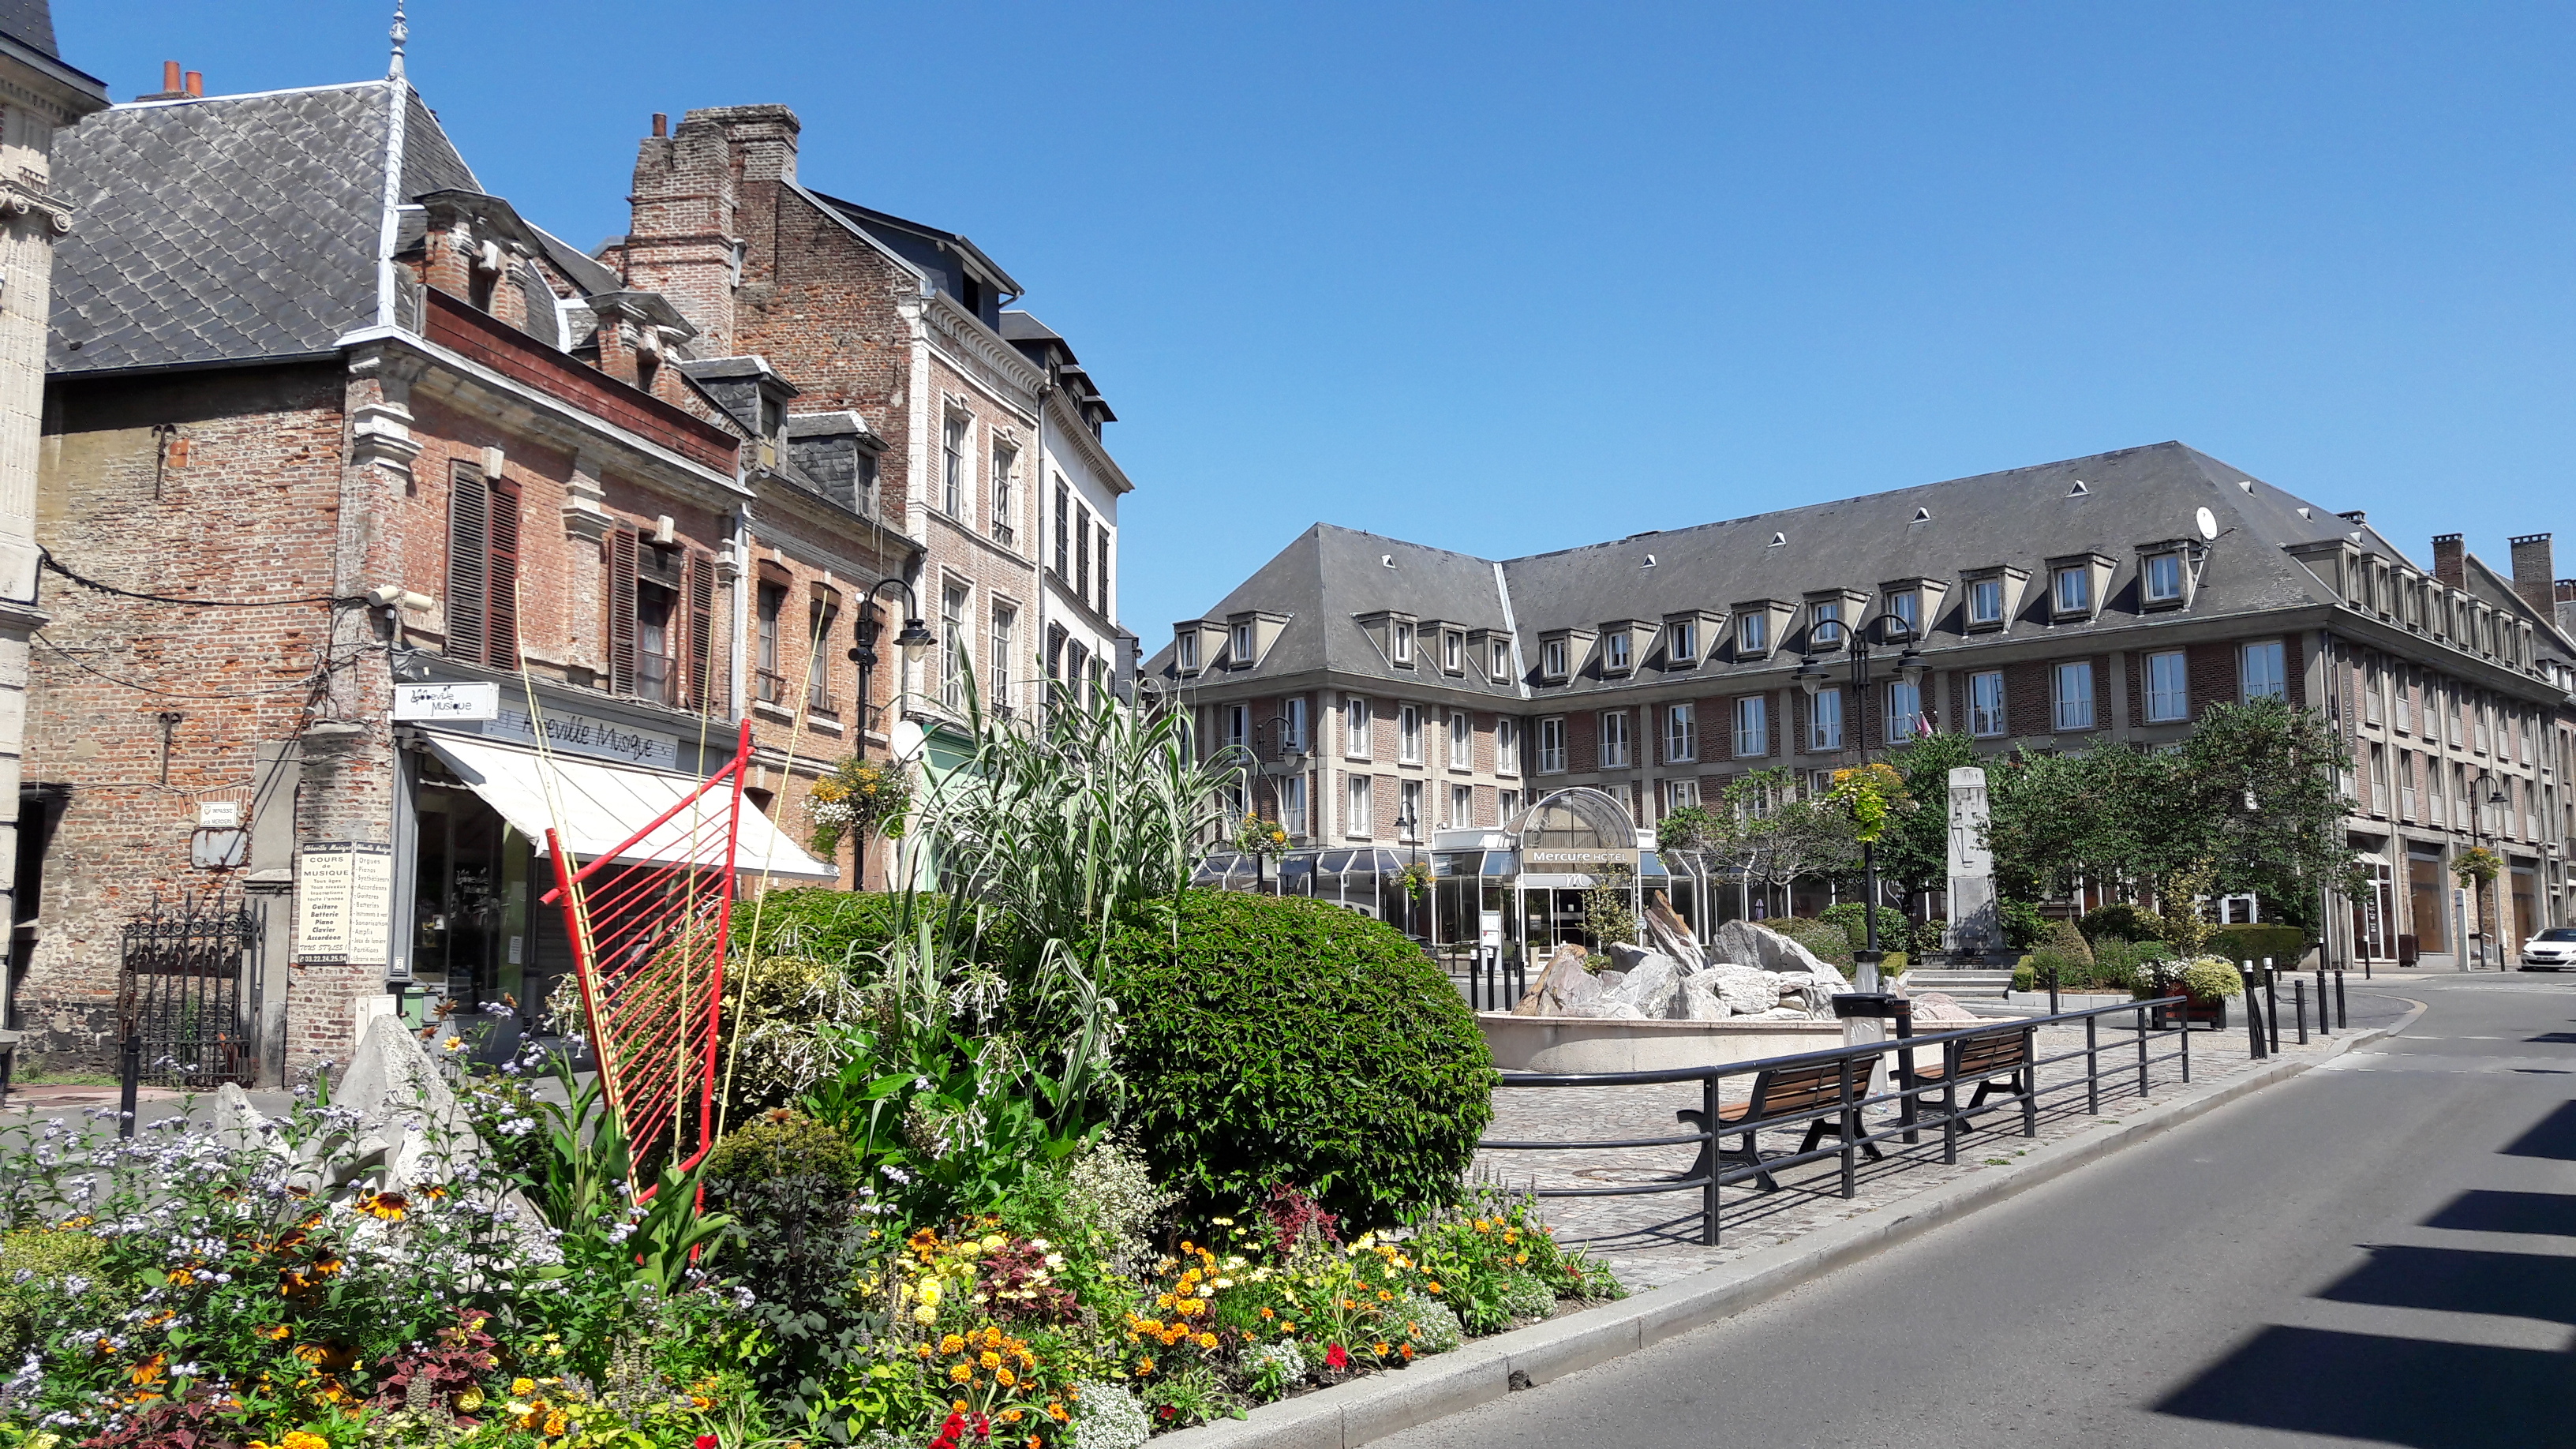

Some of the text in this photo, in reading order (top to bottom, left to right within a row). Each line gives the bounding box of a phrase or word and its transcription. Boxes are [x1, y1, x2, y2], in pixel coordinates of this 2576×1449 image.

[430, 702, 472, 717] Musique
[2344, 700, 2354, 747] Mercure
[596, 723, 653, 760] Musique
[1533, 852, 1591, 862] Mercure
